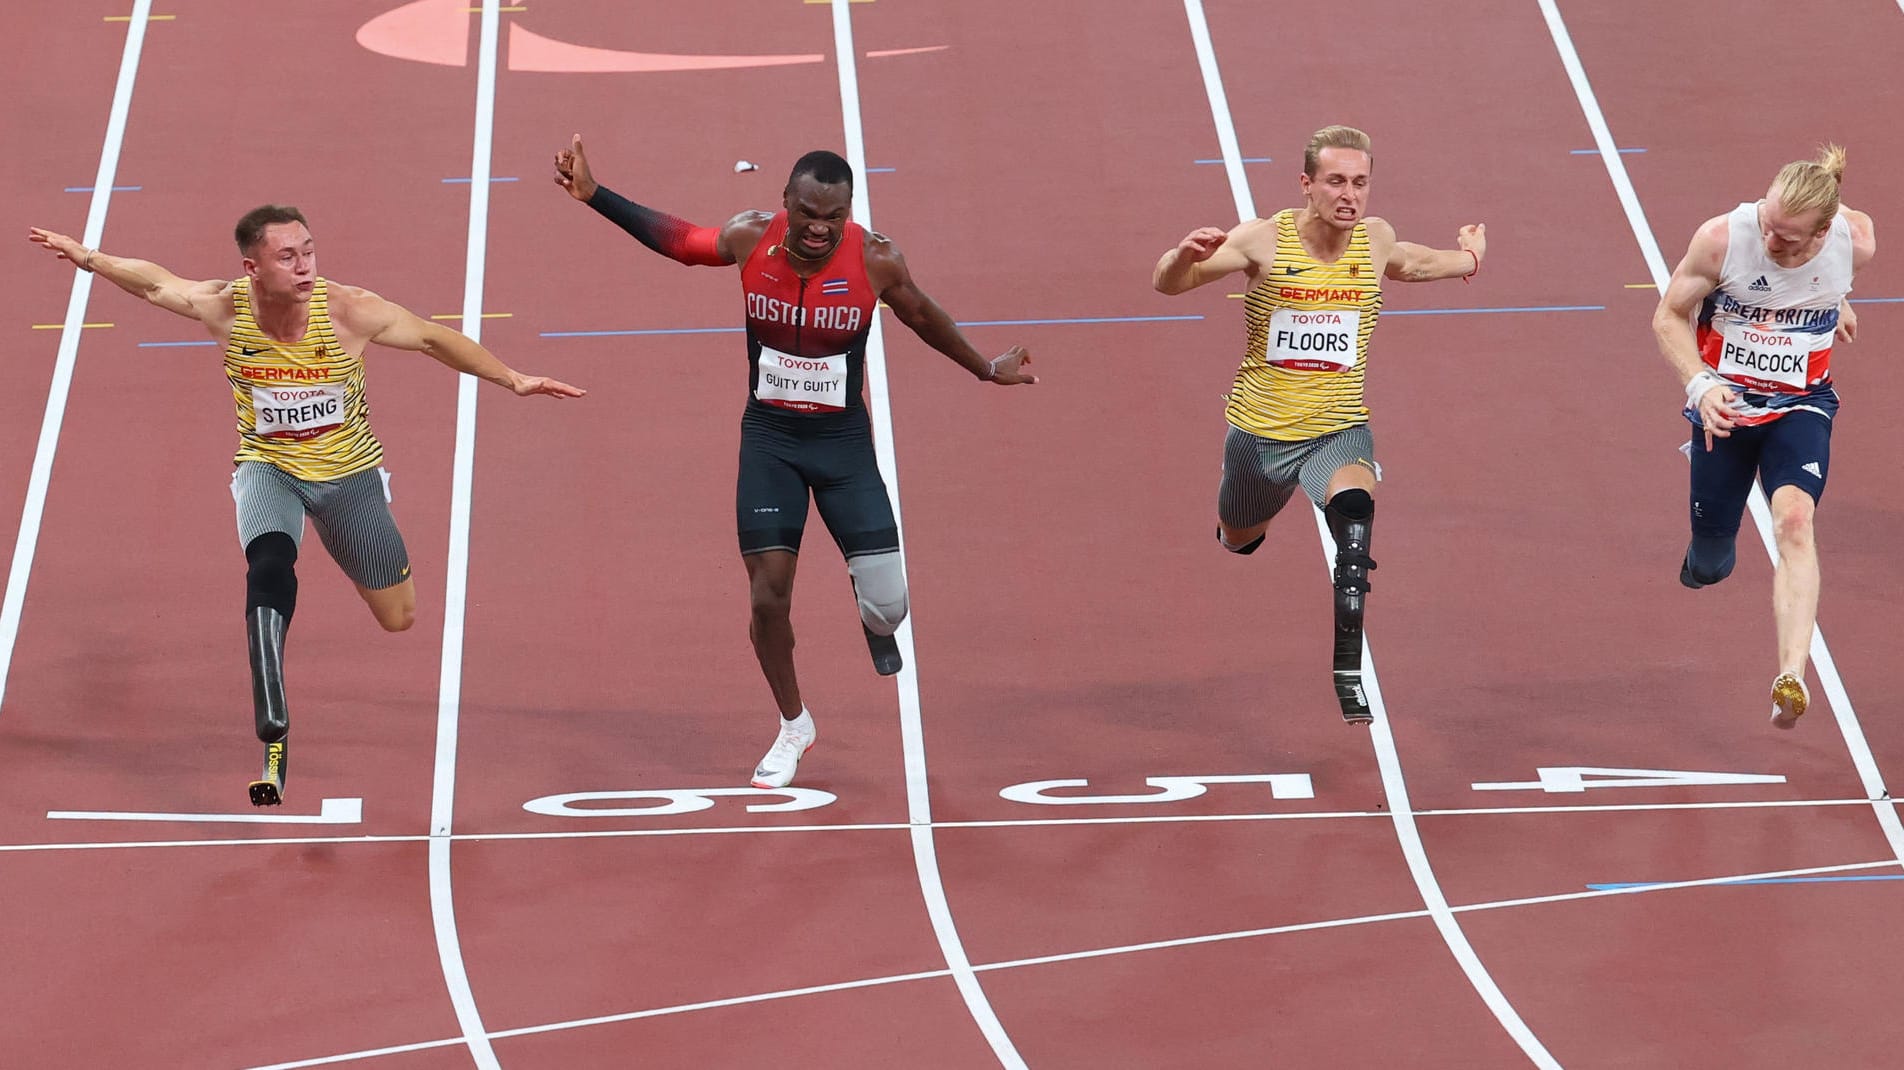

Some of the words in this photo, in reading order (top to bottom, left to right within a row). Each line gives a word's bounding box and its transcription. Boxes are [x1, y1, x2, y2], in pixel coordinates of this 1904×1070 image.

[1280, 286, 1363, 303] GERMANY
[1748, 284, 1772, 292] adidas
[747, 292, 807, 327] COSTA
[813, 305, 861, 331] RICA
[1722, 295, 1773, 322] GREAT
[1291, 314, 1341, 325] TOYOTA
[1276, 330, 1349, 352] FLOORS
[1742, 330, 1793, 347] TOYOTA
[778, 355, 830, 371] TOYOTA
[1724, 342, 1805, 373] PEACOCK
[240, 366, 330, 380] GERMANY
[766, 373, 799, 390] GUITY
[803, 379, 839, 393] GUITY
[271, 389, 325, 401] TOYOTA
[262, 398, 338, 424] STRENG
[998, 773, 1314, 804] 5
[1471, 766, 1787, 792] 4
[523, 787, 837, 817] 6
